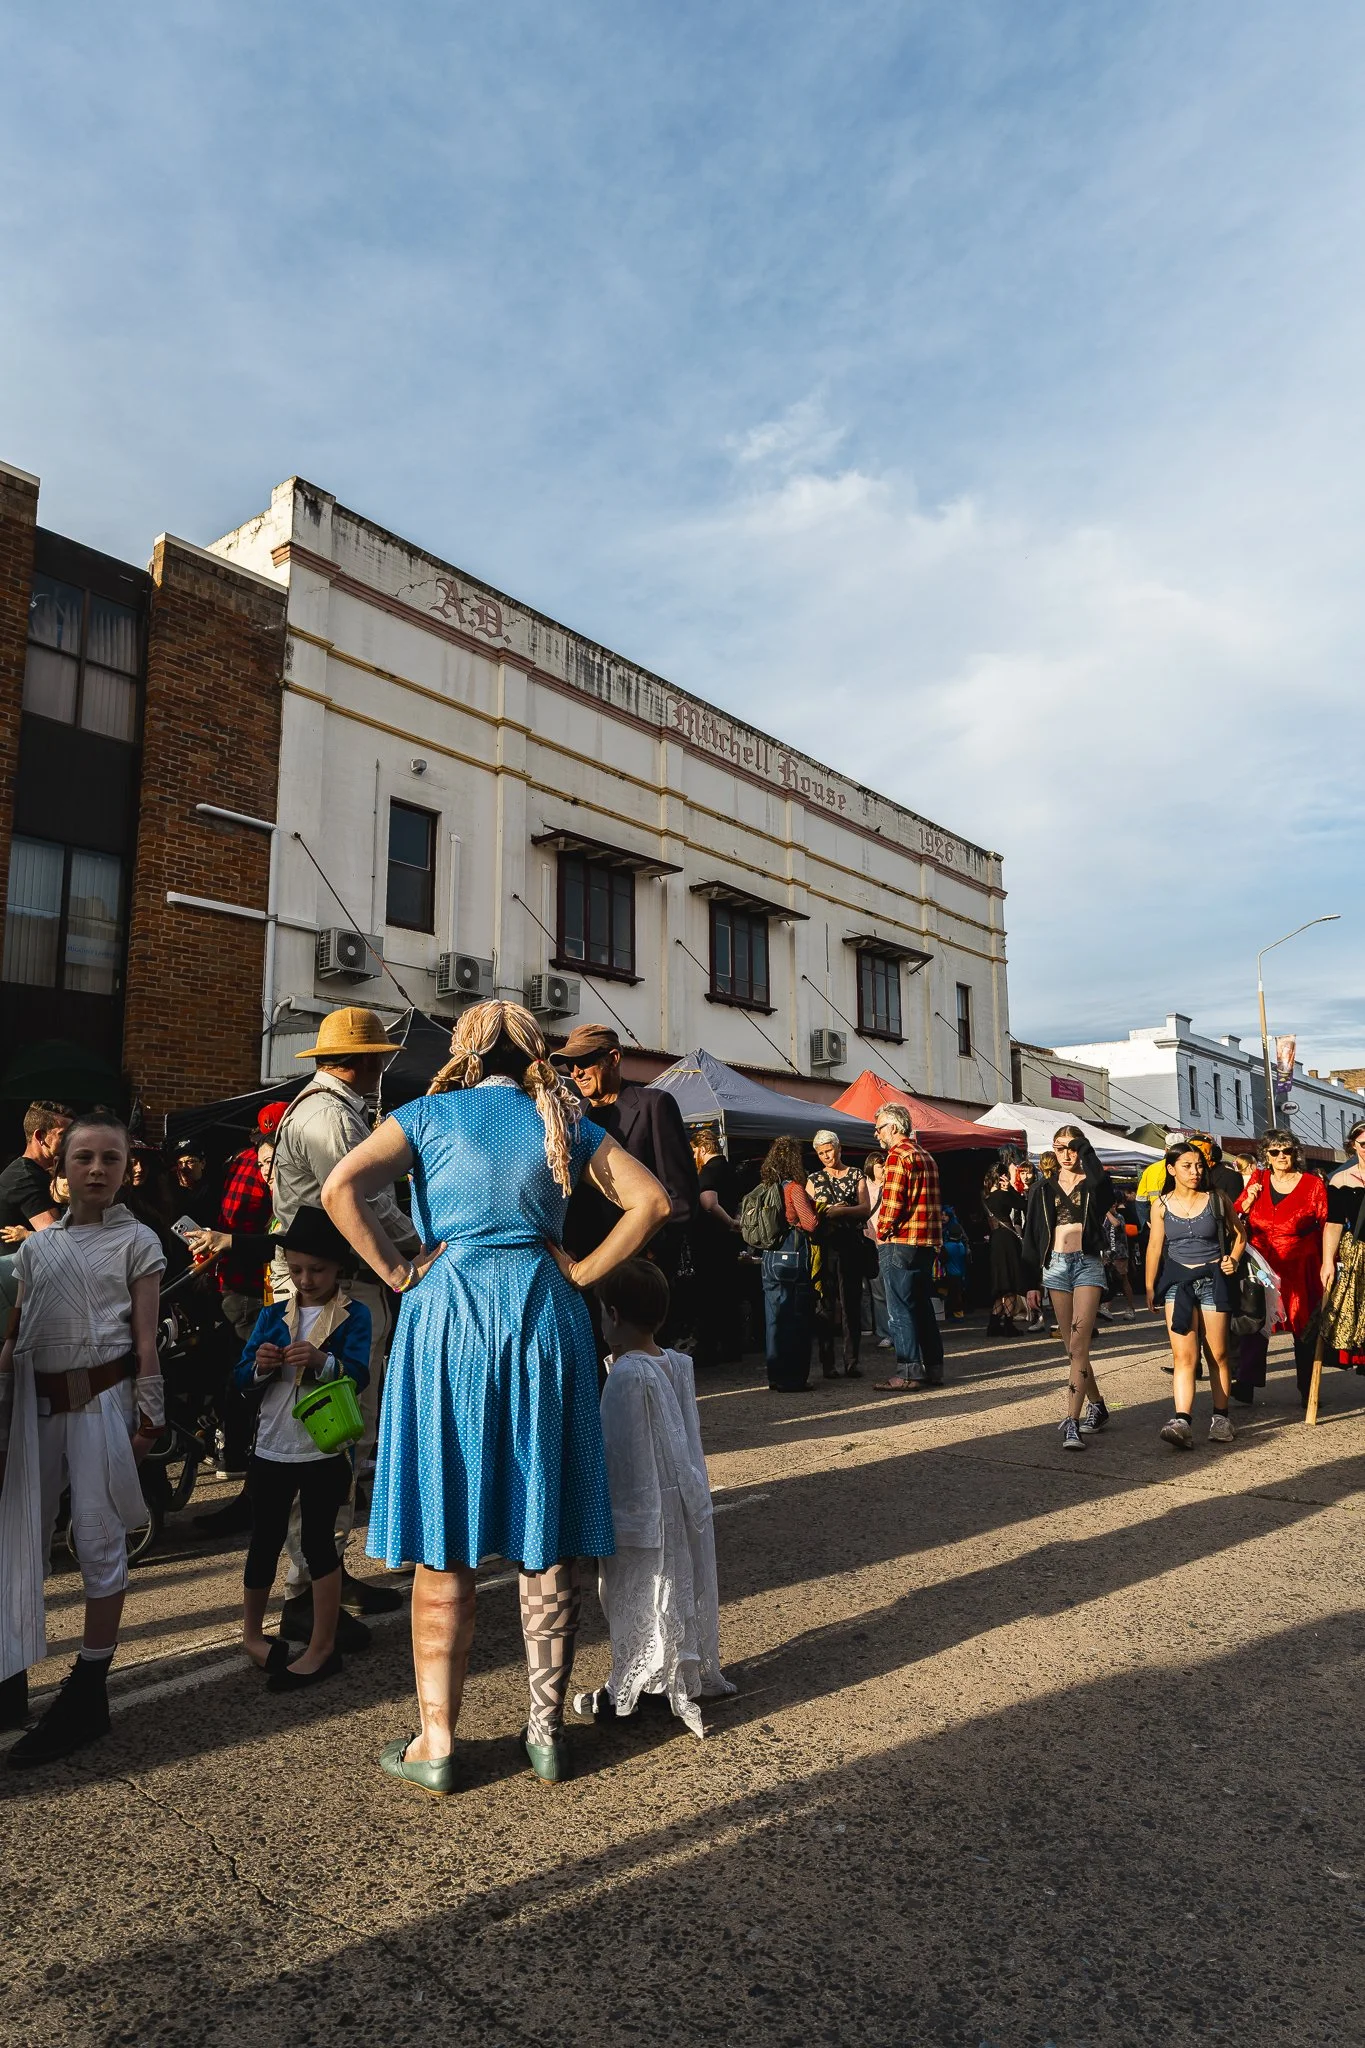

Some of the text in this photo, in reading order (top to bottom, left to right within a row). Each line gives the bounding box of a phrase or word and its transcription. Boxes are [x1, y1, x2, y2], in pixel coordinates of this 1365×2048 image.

[429, 577, 512, 644] A.D.
[667, 694, 847, 811] Mitchell House
[919, 827, 955, 863] 1926
